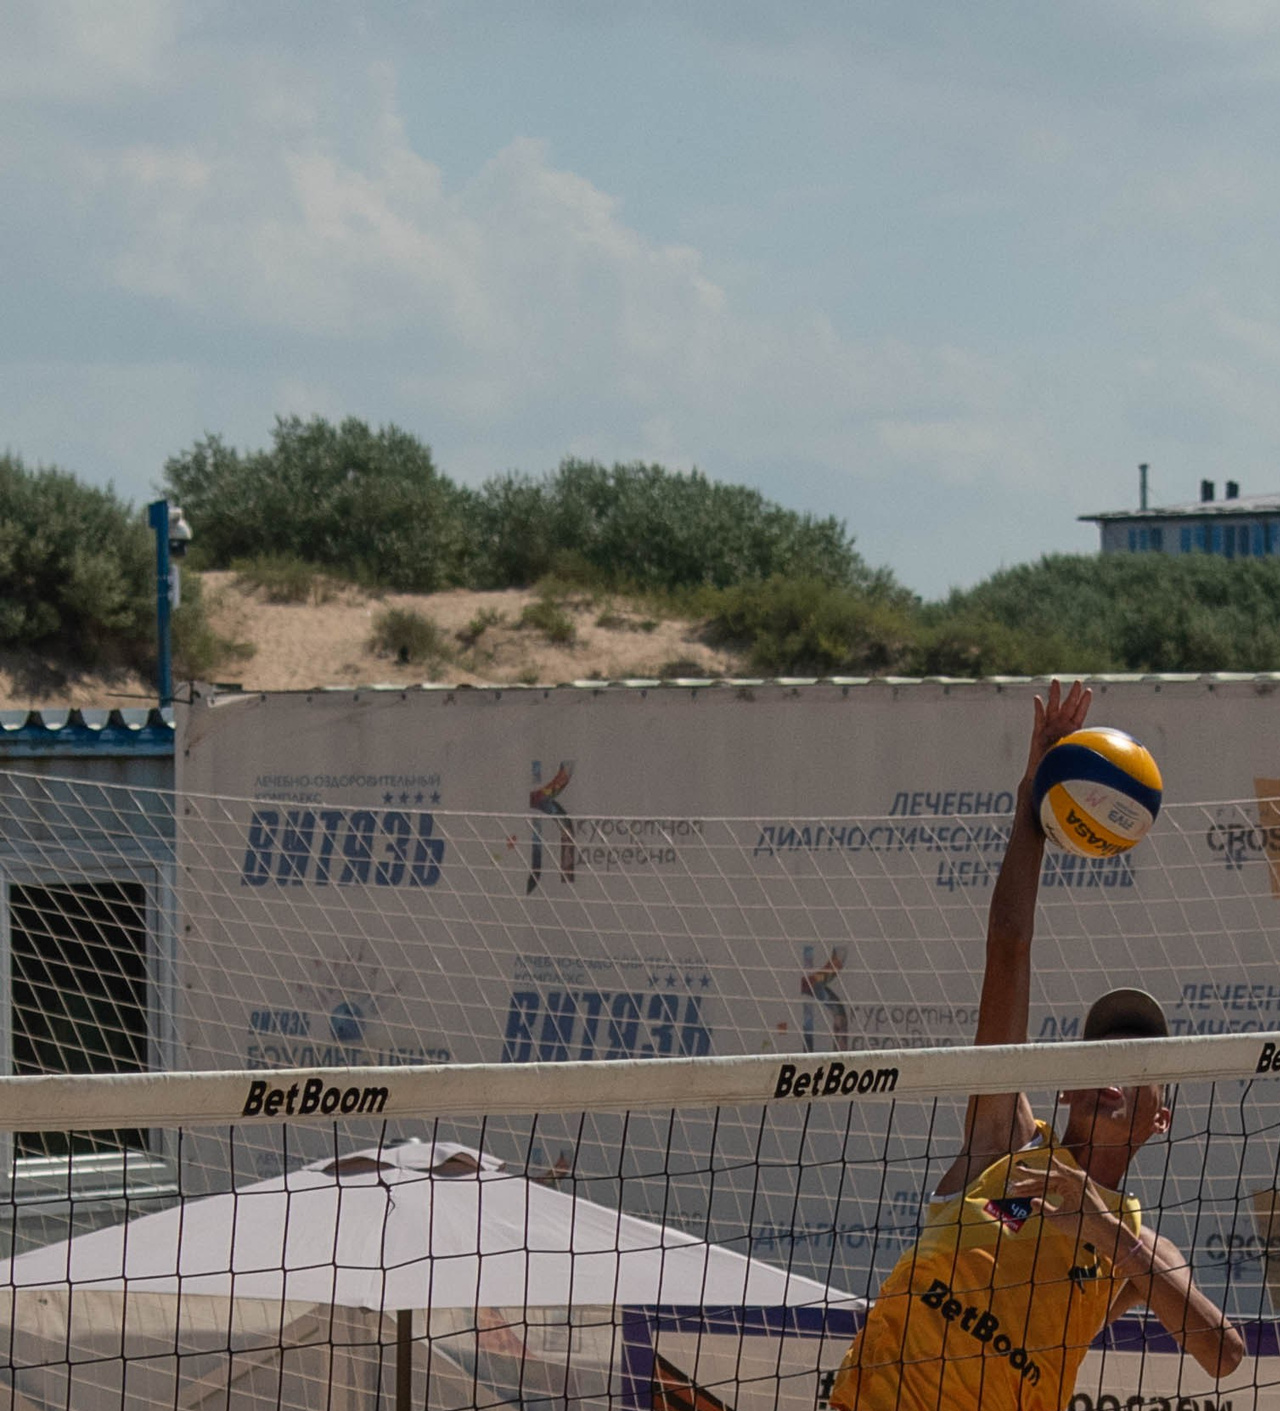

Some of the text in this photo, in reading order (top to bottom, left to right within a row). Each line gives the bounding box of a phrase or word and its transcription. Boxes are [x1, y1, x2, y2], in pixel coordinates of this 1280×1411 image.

[241, 811, 445, 887] ВИТЯЗЬ
[753, 825, 1012, 857] ДИАГНОСТИЧЕСКИ
[501, 991, 714, 1063] ВИТЯЗЬ
[241, 1077, 389, 1117] BetBoom
[774, 1061, 899, 1098] BetBoom
[920, 1279, 1042, 1387] BetBoom
